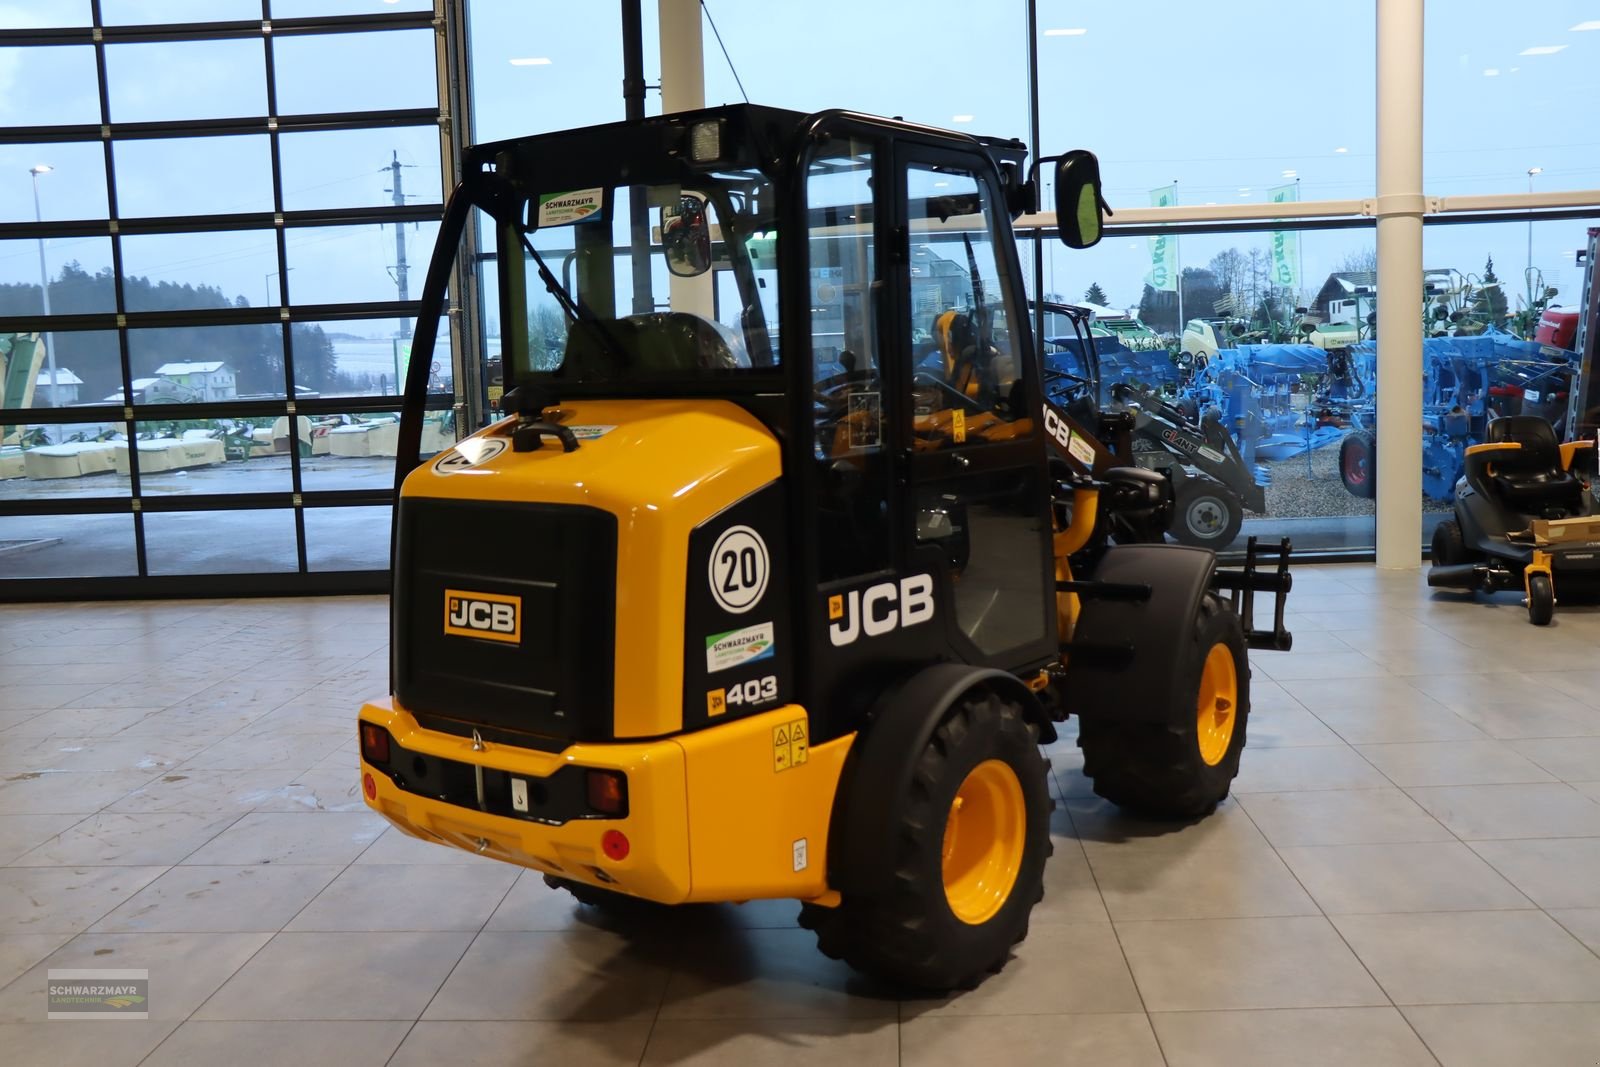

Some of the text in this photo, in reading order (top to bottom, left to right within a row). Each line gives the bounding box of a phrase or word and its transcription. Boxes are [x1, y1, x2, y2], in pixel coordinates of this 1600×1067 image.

[545, 197, 594, 210] SCHWARZMAYR
[721, 547, 757, 593] 20
[450, 599, 515, 633] JCB
[829, 574, 934, 647] JCB
[713, 633, 764, 652] SCHWARZMAYR
[726, 675, 778, 705] 403
